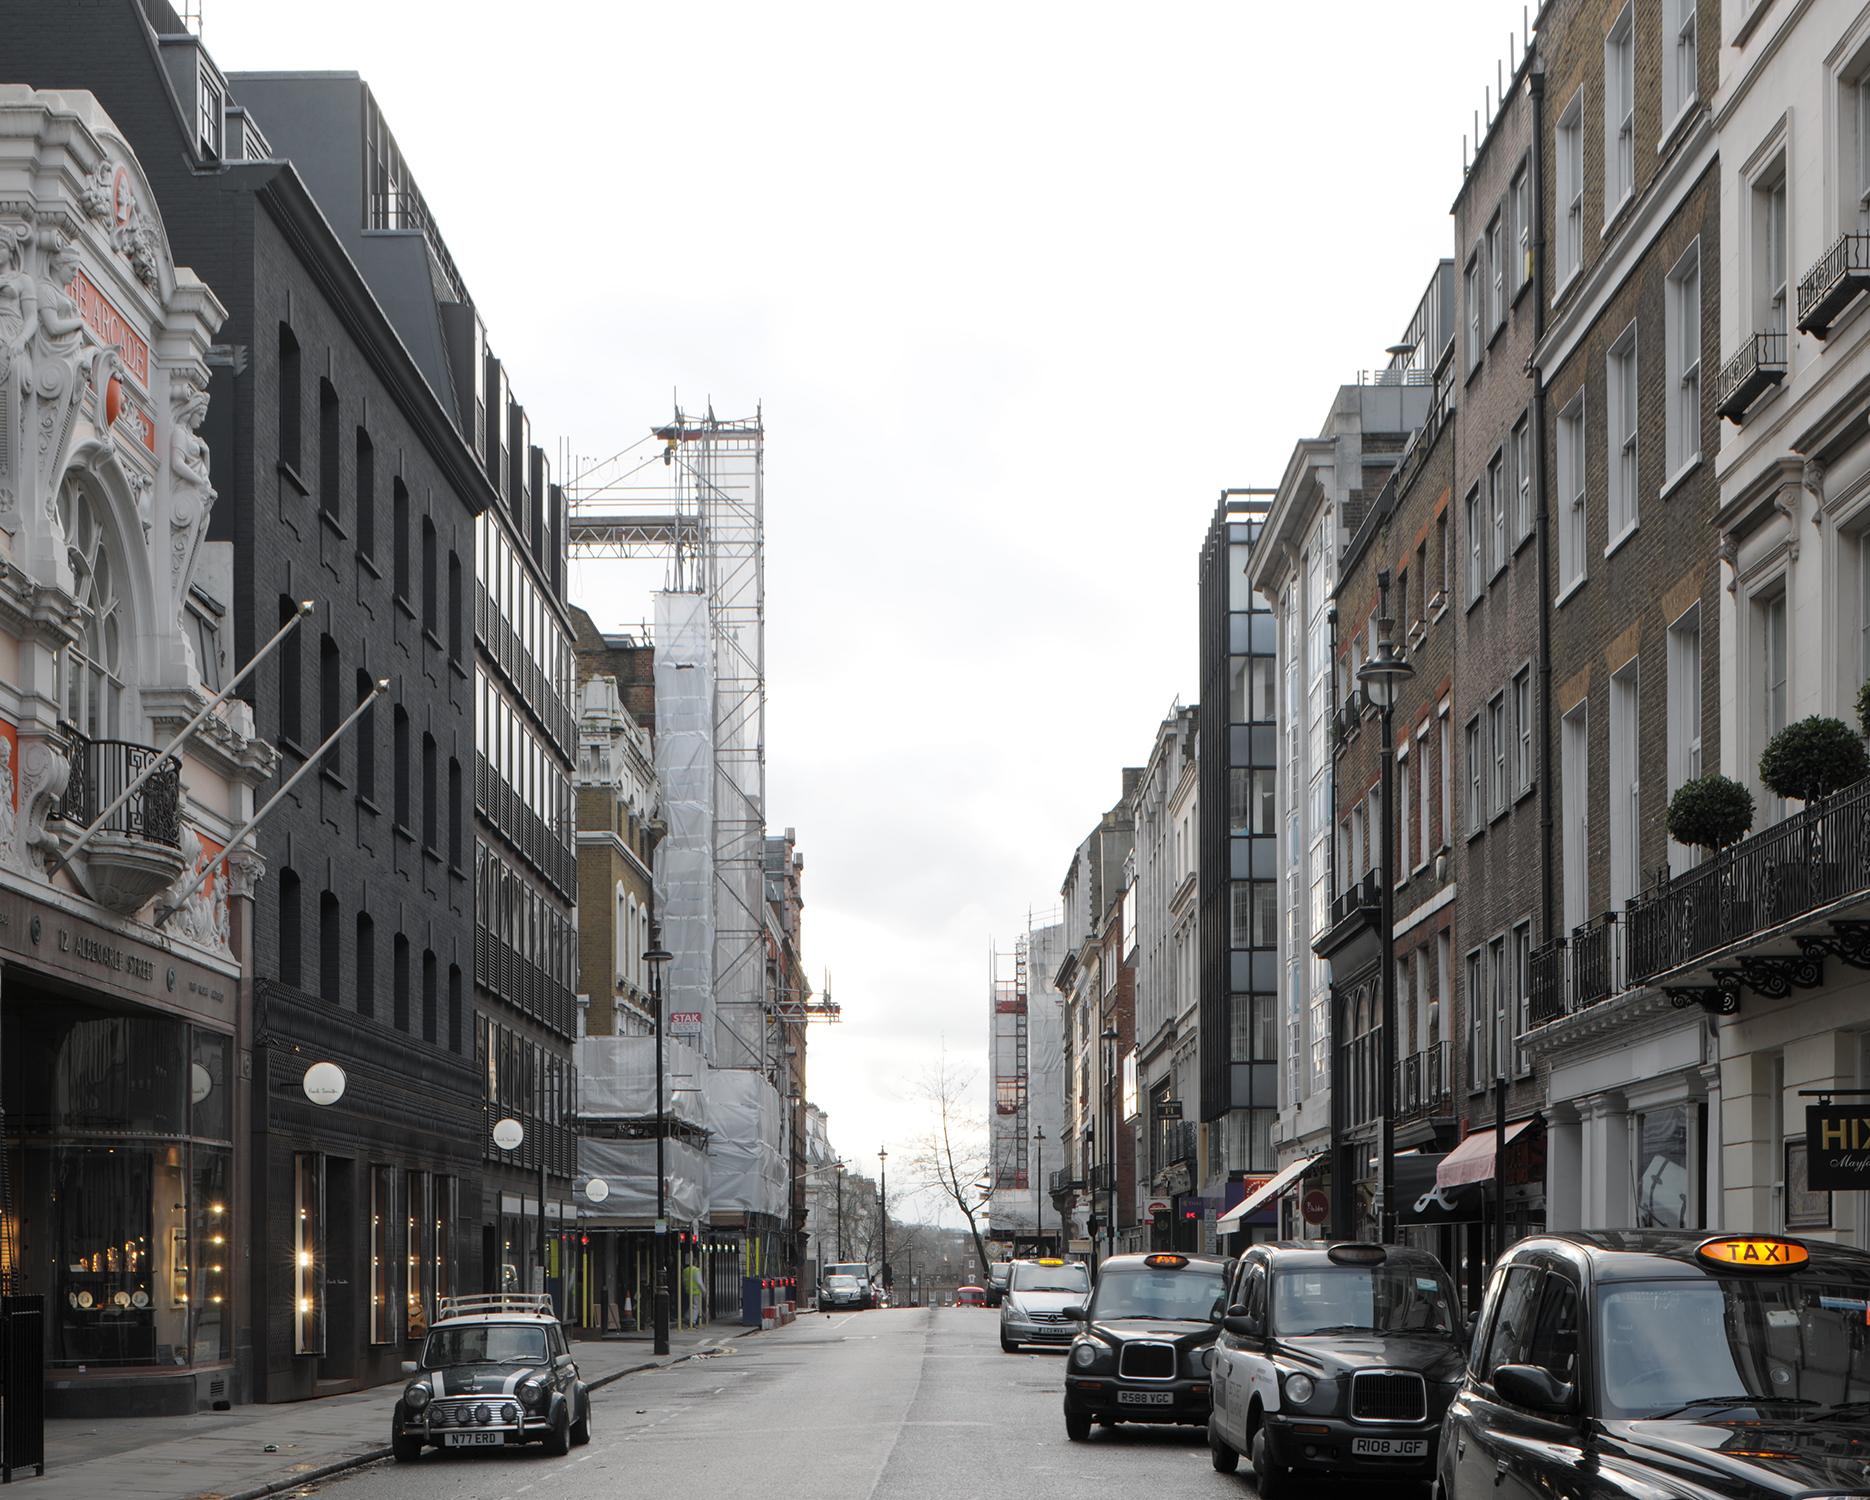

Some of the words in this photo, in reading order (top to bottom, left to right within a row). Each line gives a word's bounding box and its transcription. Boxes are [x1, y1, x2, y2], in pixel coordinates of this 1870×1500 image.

[91, 296, 144, 380] ARCADE
[59, 927, 70, 952] 12
[75, 936, 124, 972] ALBEMARLE
[127, 954, 156, 981] STREET
[673, 1013, 699, 1023] STAK
[1726, 1244, 1790, 1262] TAXI
[1121, 1393, 1147, 1403] R588
[1150, 1393, 1169, 1403] VGC
[452, 1433, 472, 1444] N77
[475, 1433, 496, 1444] ERD
[1394, 1441, 1423, 1454] JGF
